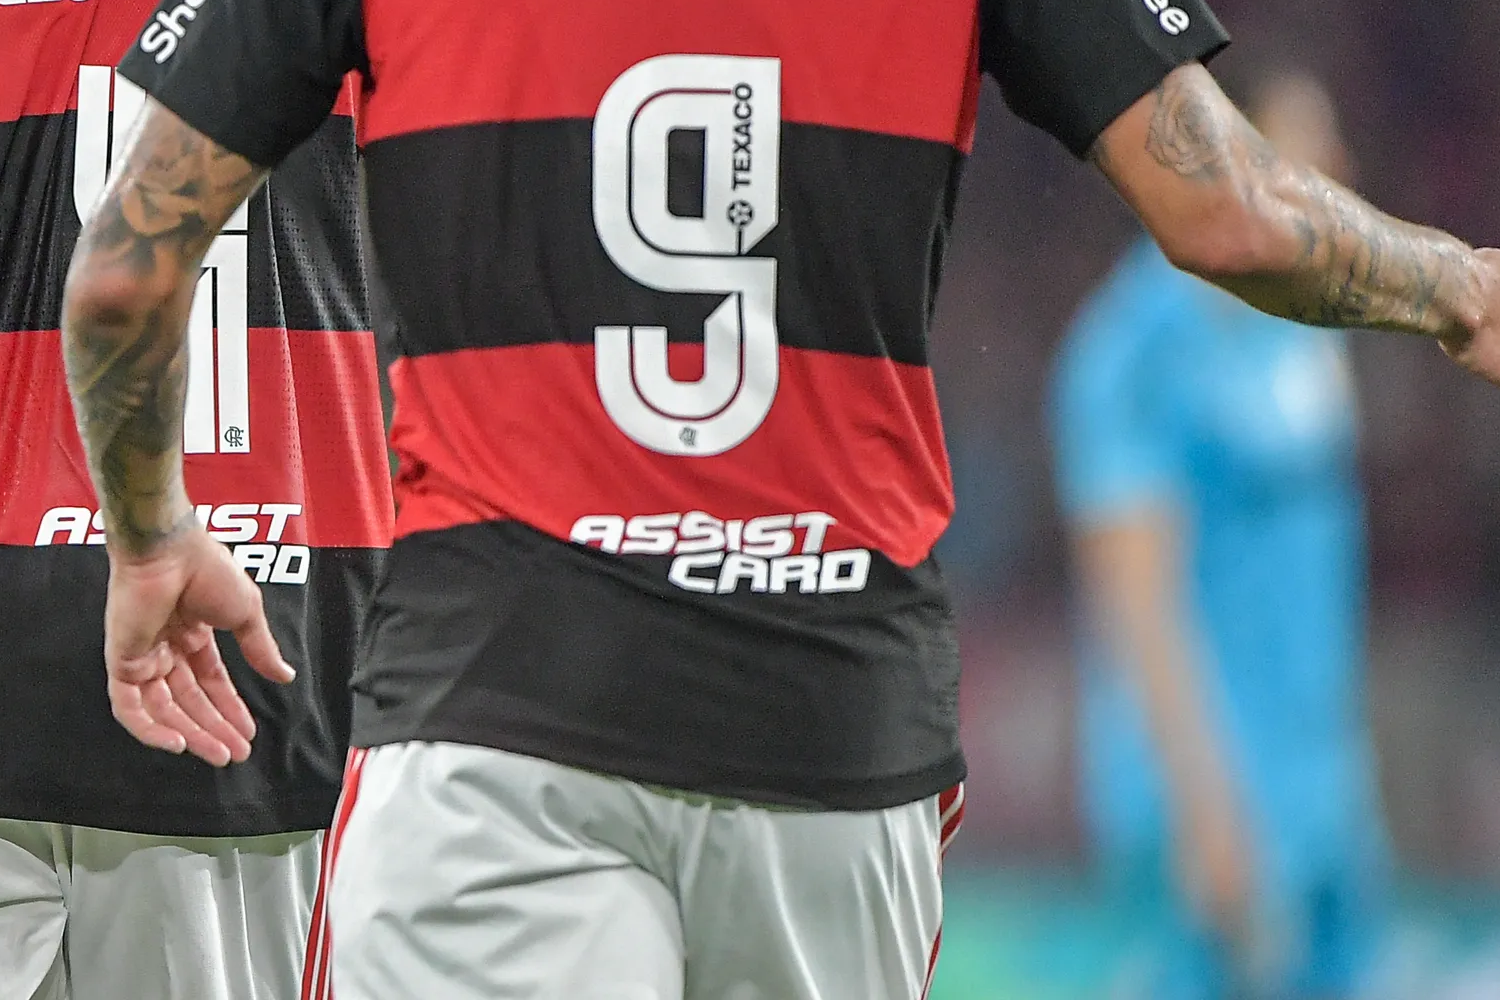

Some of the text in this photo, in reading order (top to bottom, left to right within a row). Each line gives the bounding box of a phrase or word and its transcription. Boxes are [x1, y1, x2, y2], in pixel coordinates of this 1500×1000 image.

[730, 81, 754, 191] TEXACO
[591, 53, 782, 457] 9
[34, 503, 302, 547] AIST
[569, 510, 838, 557] ASSIST
[232, 544, 311, 585] RD
[667, 548, 873, 595] CARD
